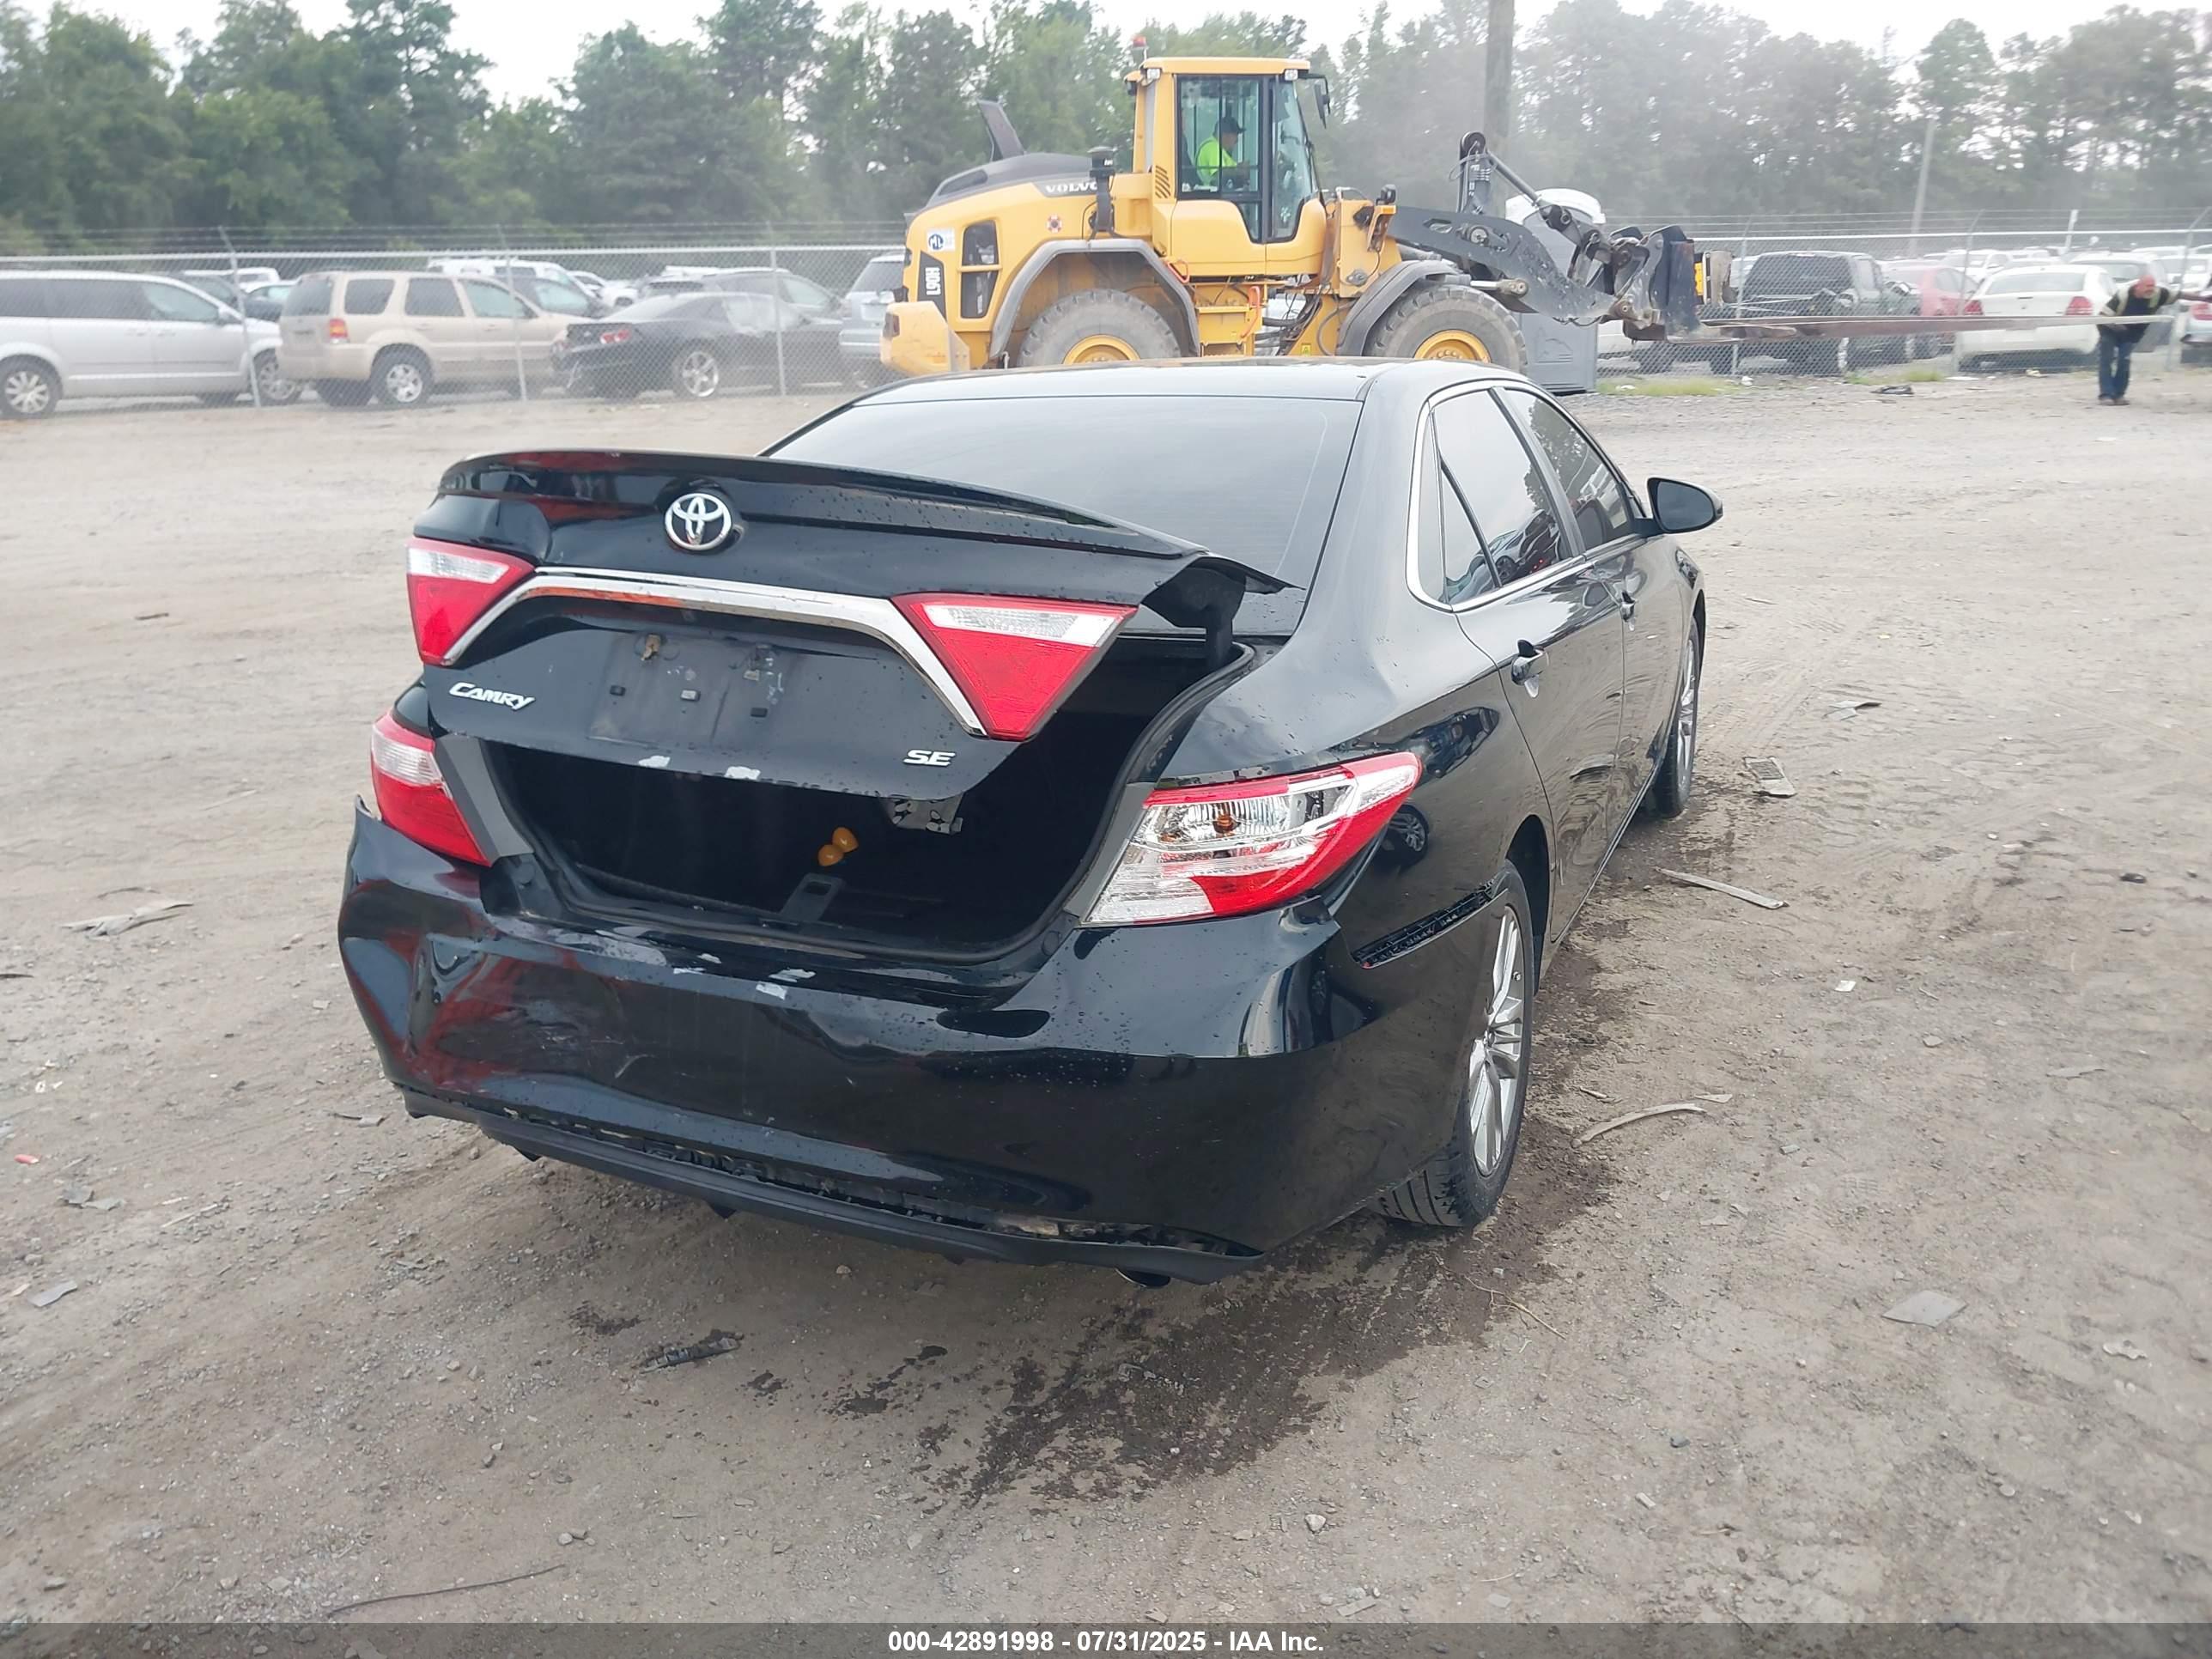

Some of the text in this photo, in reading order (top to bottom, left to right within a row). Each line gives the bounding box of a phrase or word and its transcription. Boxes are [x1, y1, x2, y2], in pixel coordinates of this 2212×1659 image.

[1045, 181, 1098, 193] VOLVO
[448, 682, 536, 710] CAMRY
[903, 749, 956, 767] SE
